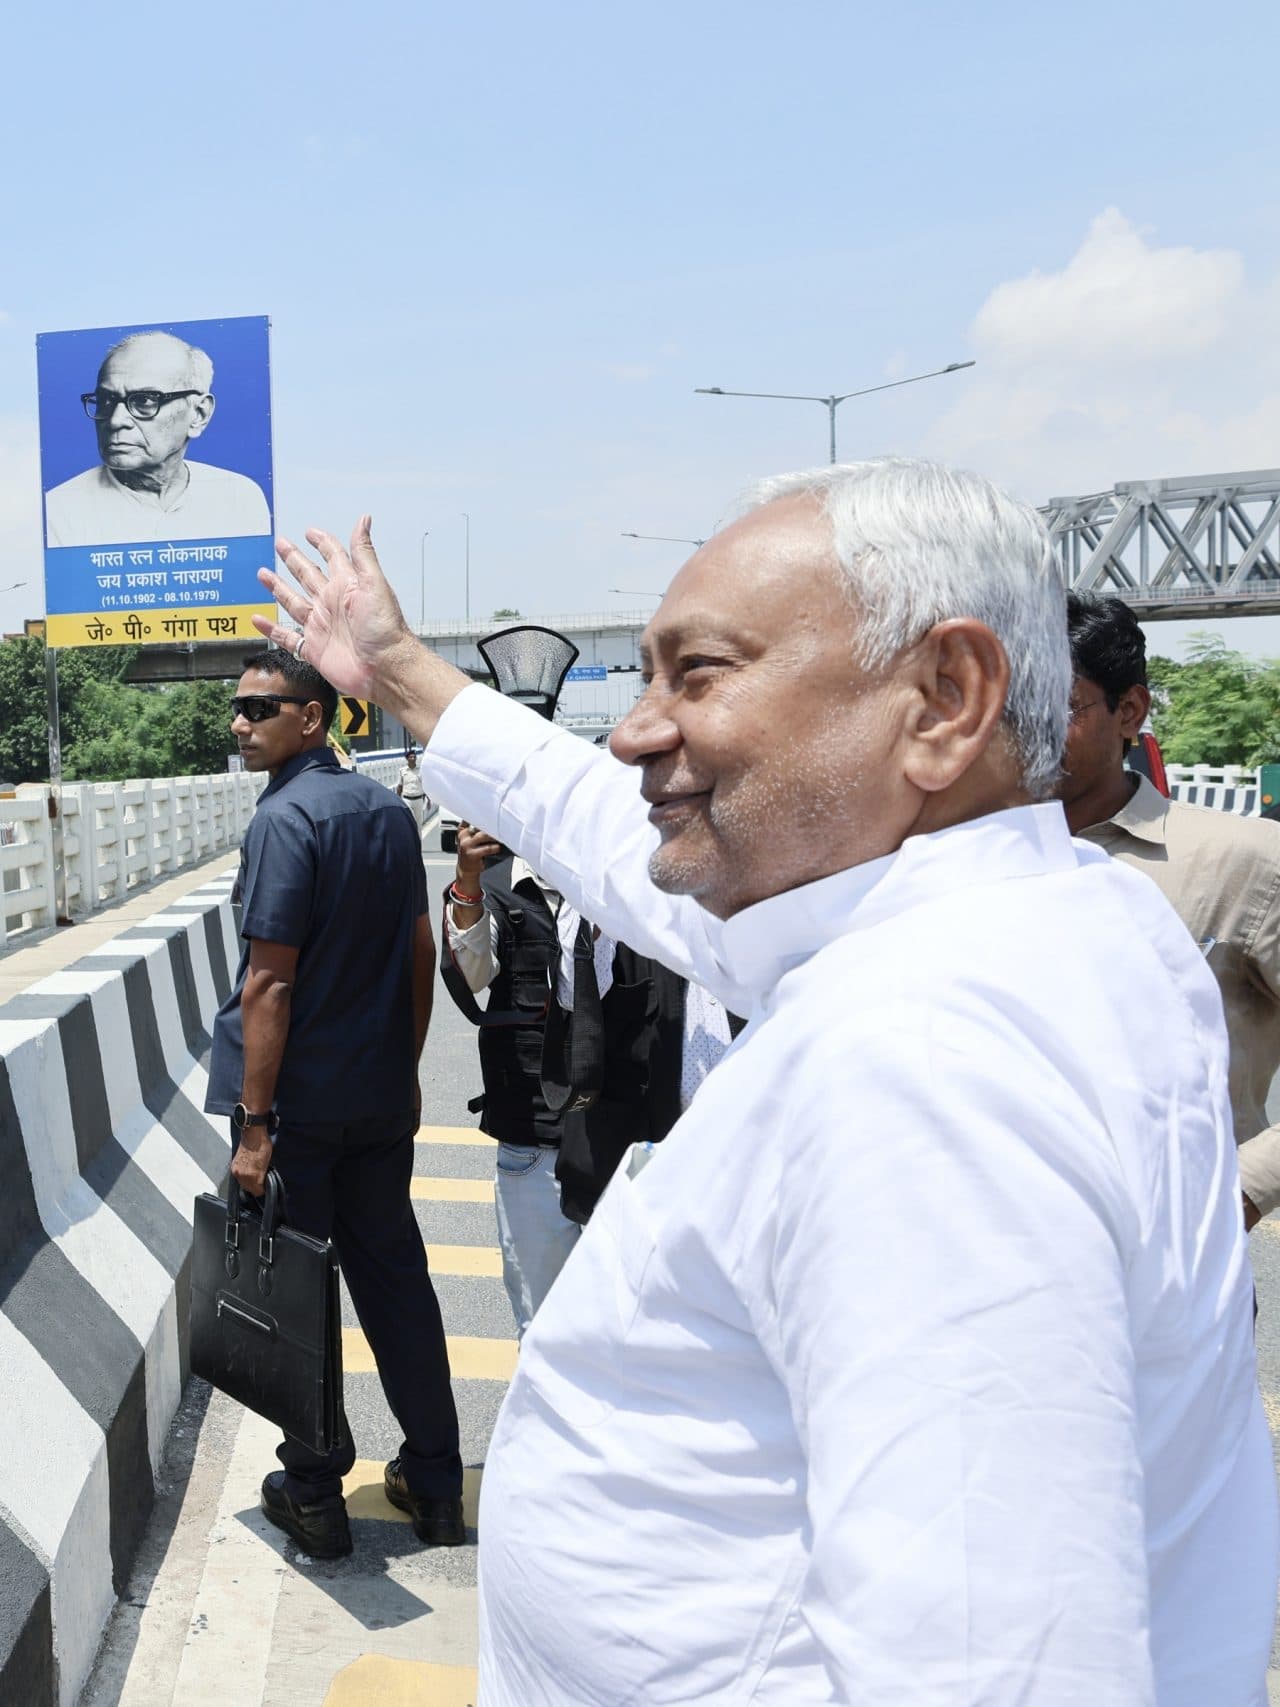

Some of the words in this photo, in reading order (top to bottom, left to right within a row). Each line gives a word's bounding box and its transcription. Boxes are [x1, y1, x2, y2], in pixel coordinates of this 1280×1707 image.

[89, 551, 124, 568] भारत
[127, 550, 153, 565] रत्न
[157, 542, 228, 564] लोकनायक
[96, 574, 121, 589] जय
[125, 572, 168, 588] प्रकाश
[171, 568, 223, 585] नारायण
[101, 593, 156, 608] (11.10.1902
[164, 590, 220, 602] 08.10.1979)
[161, 614, 198, 638] गंगा
[206, 616, 238, 636] पथ
